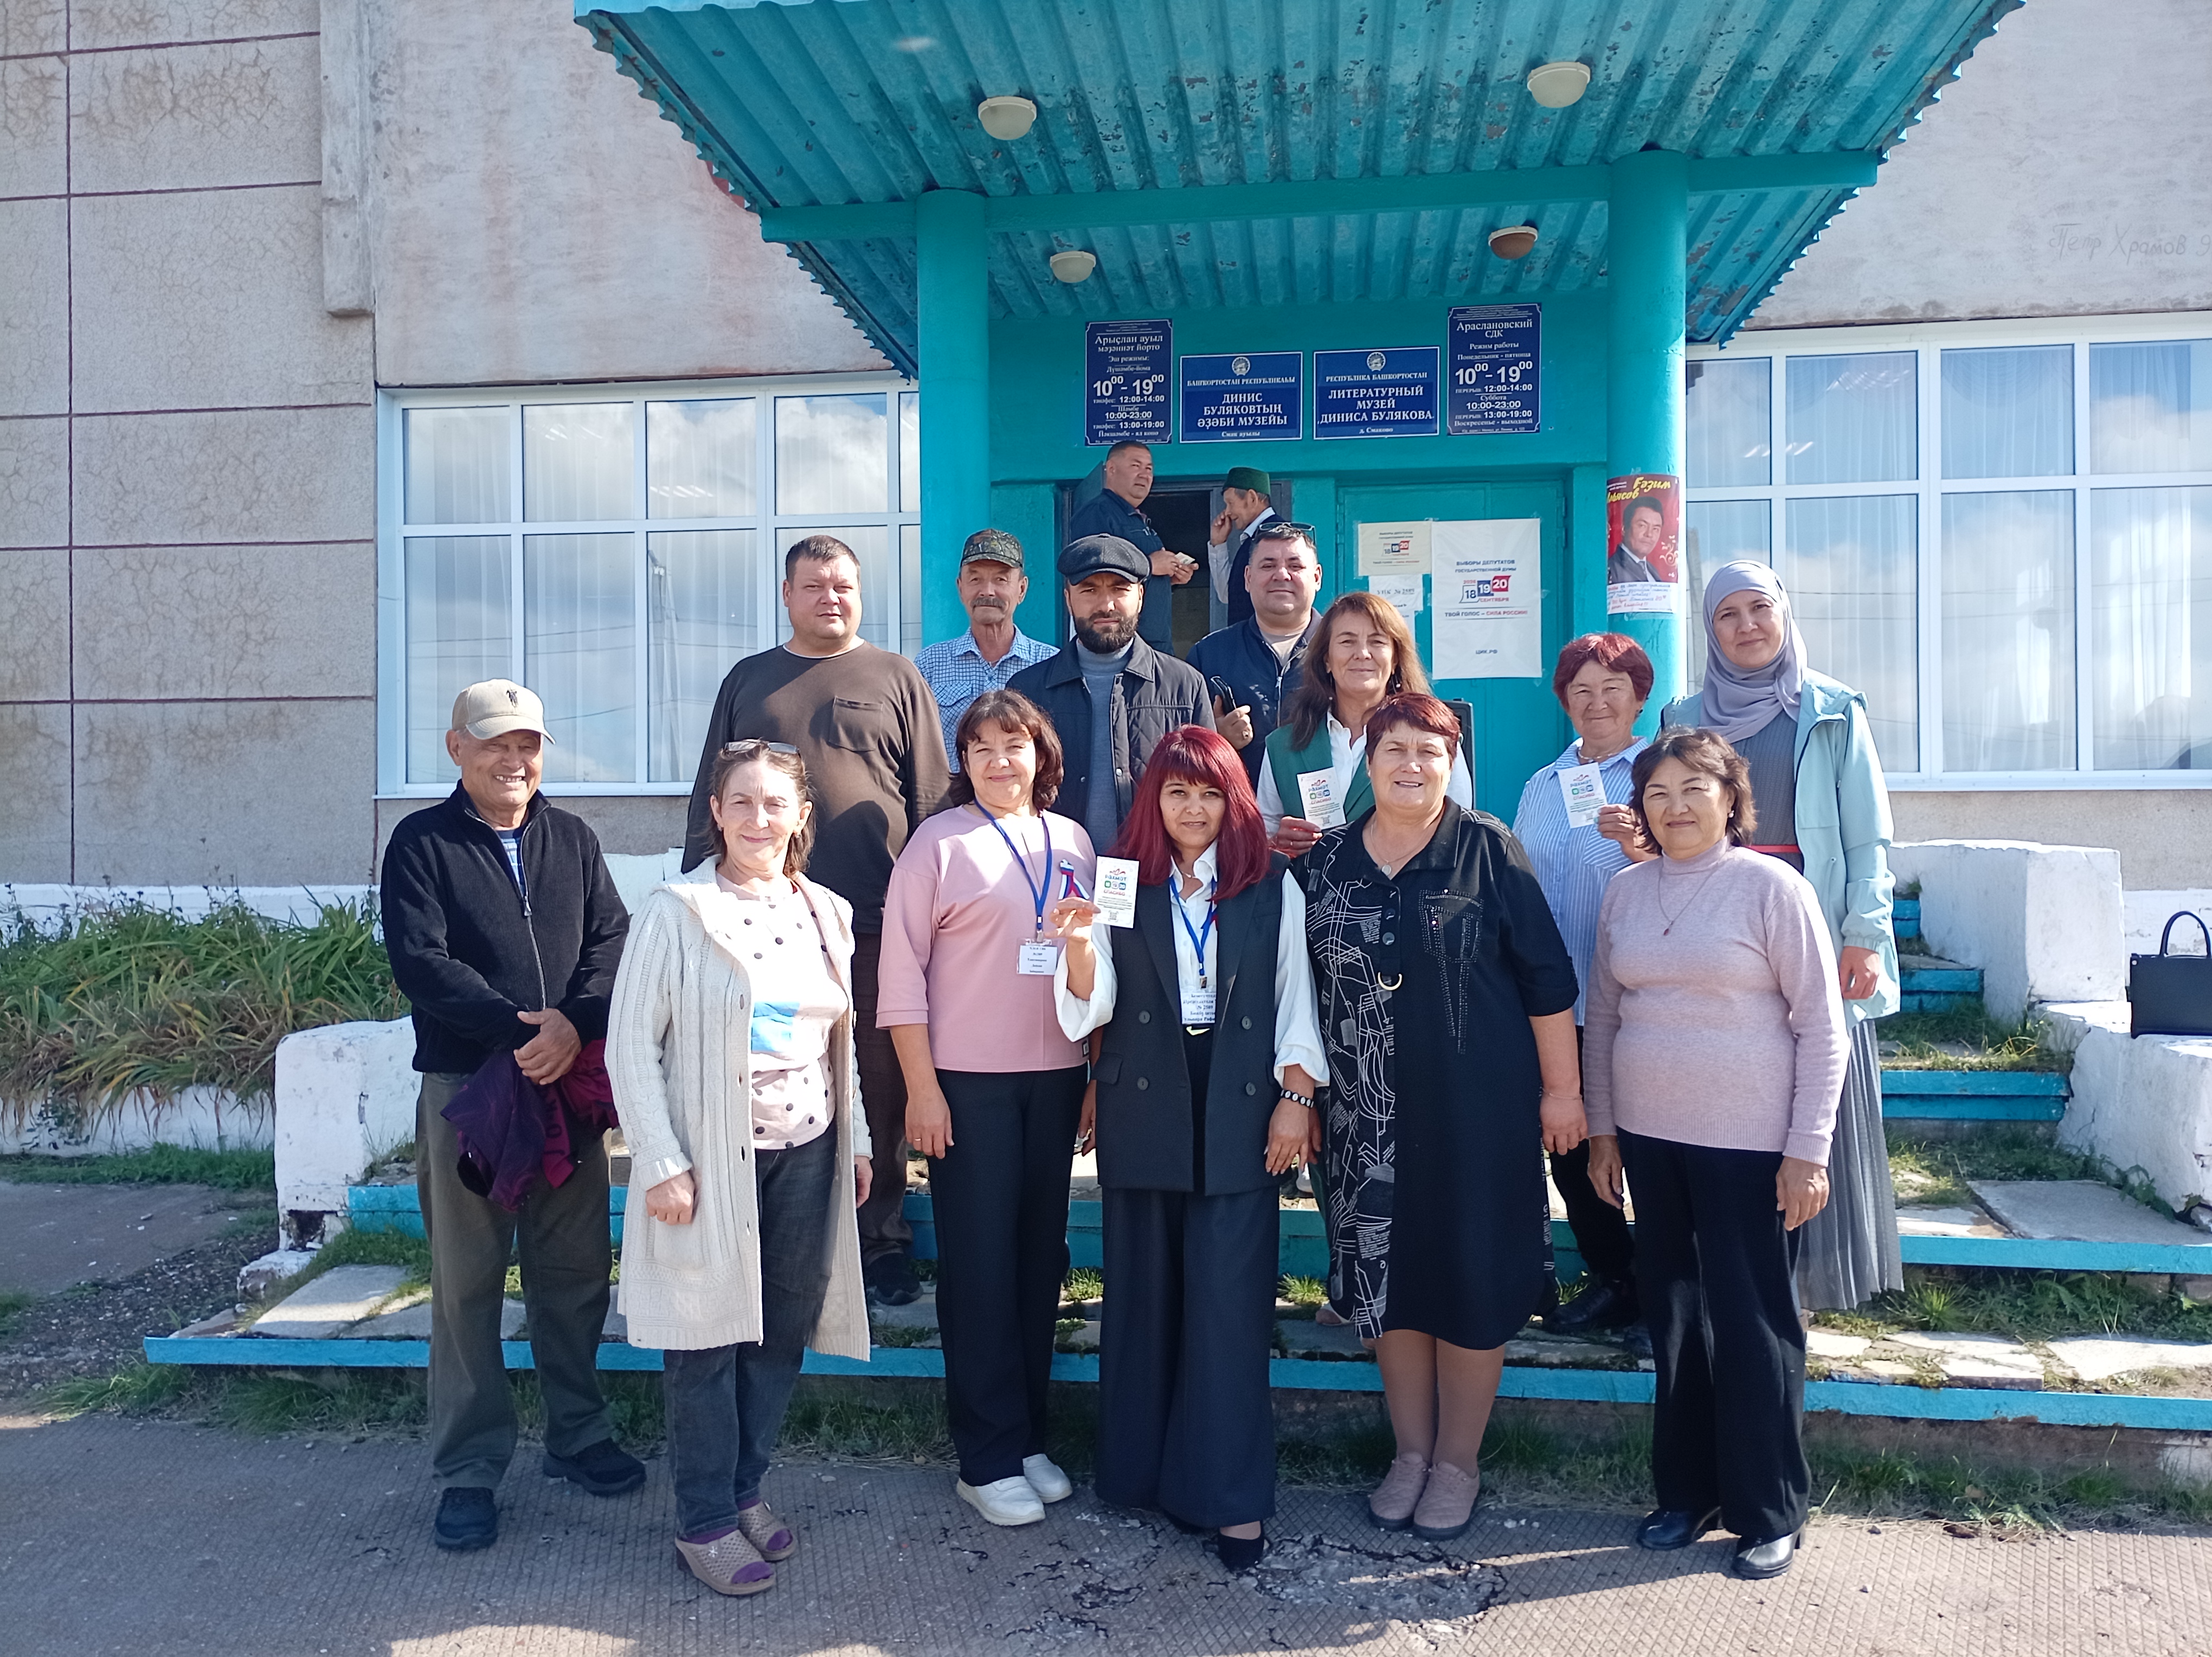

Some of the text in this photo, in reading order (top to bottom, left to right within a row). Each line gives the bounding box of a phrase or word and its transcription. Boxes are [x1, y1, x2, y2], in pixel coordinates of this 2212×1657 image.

[2108, 223, 2187, 266] Храмов
[1456, 319, 1533, 333] Араслановский
[1485, 330, 1503, 338] СДК
[1140, 335, 1163, 344] ауыл
[1136, 344, 1160, 352] йорто
[1494, 342, 1519, 350] работы
[1326, 372, 1427, 382] РЕСПУБЛИКА БАШКОРТОСТАН
[1328, 384, 1424, 399] ЛИТЕРАТУРНЫЙ
[1484, 384, 1533, 392] 12:00-14:00
[1119, 395, 1165, 403] 12:00-14:00
[1221, 393, 1263, 404] ДИНИС
[1356, 397, 1396, 409] МУЗЕЙ
[1204, 403, 1283, 416] БУЛЯКОВТЫҢ
[1466, 401, 1521, 409] 10:00-23:00
[1105, 411, 1152, 419] 10:00-23:00
[1484, 410, 1532, 418] 13:00-19:00
[1197, 414, 1288, 429] ӘҘӘБИ МУЗЕЙЫ
[1478, 583, 1491, 594] 19
[1493, 579, 1508, 589] 20
[1464, 589, 1477, 599] 18
